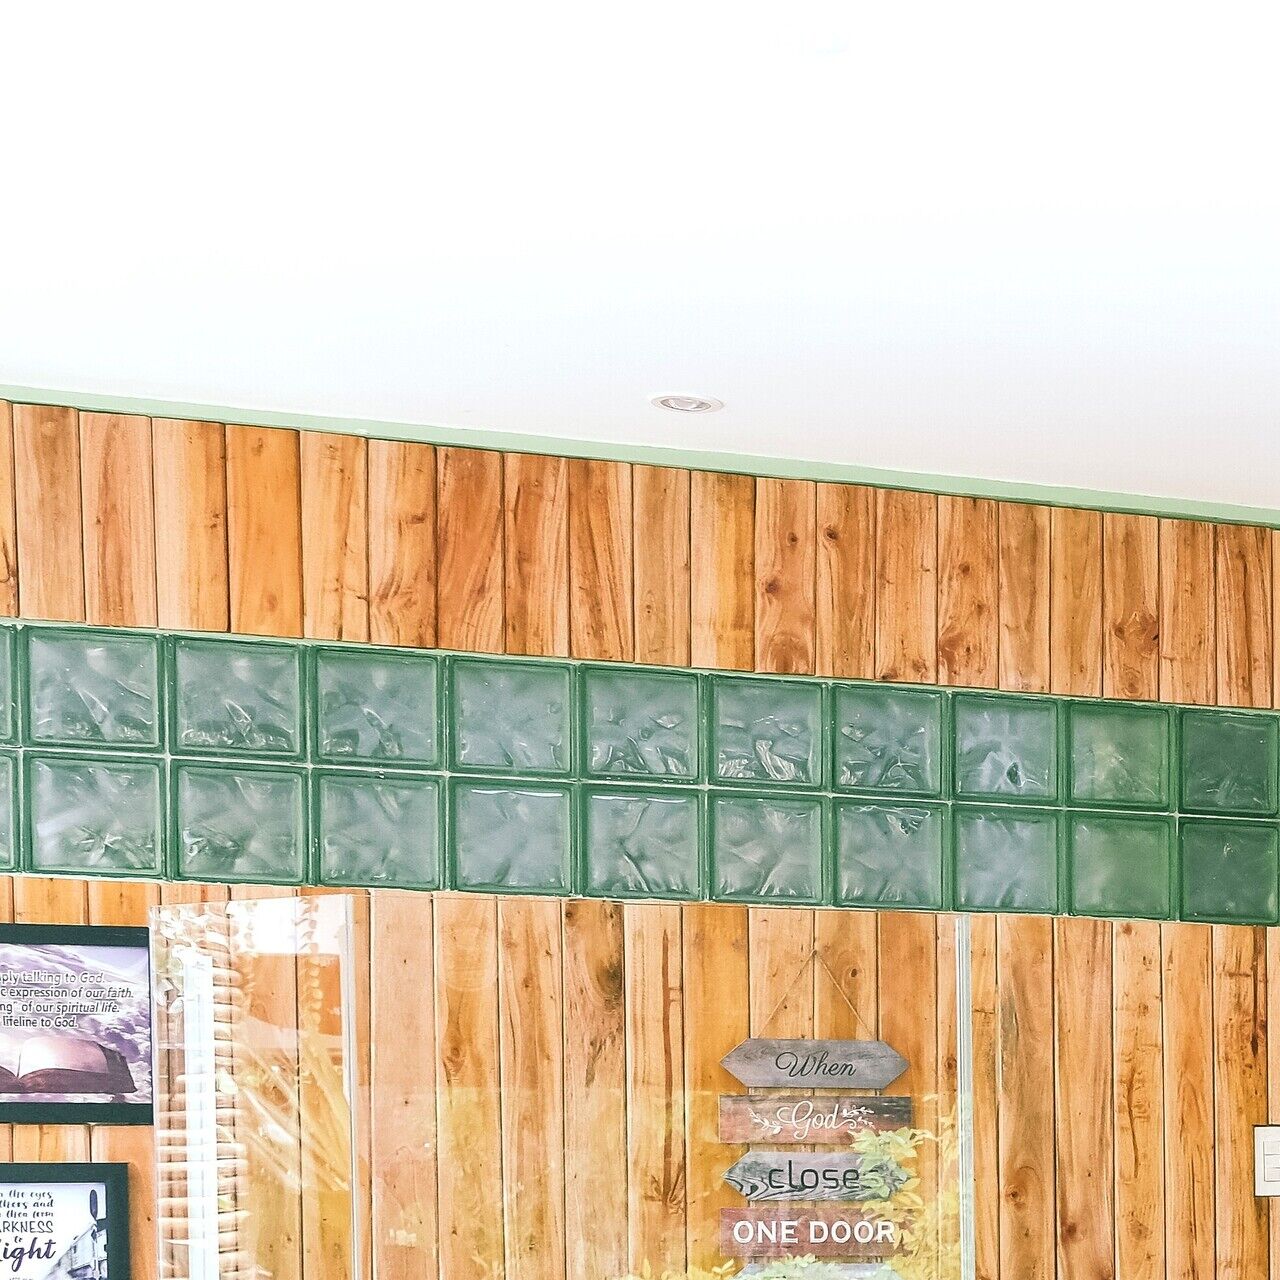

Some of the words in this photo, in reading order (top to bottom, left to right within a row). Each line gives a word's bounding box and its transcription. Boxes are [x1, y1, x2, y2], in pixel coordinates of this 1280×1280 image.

[23, 971, 61, 985] talking
[65, 973, 76, 983] to
[80, 972, 105, 983] God.
[10, 987, 68, 998] expression
[71, 987, 84, 998] of
[86, 989, 104, 998] our
[107, 987, 134, 998] faith.
[22, 1001, 32, 1013] of
[35, 1003, 54, 1012] our
[56, 1001, 99, 1016] spiritual
[101, 1001, 120, 1013] life.
[3, 1016, 38, 1028] lifeline
[41, 1018, 51, 1028] to
[54, 1017, 78, 1028] God.
[775, 1051, 857, 1078] When
[775, 1100, 846, 1140] God
[767, 1159, 886, 1191] closes
[0, 1220, 54, 1234] RKNESS
[733, 1220, 799, 1244] ONE
[809, 1219, 897, 1244] DOOR
[0, 1236, 57, 1273] ight
